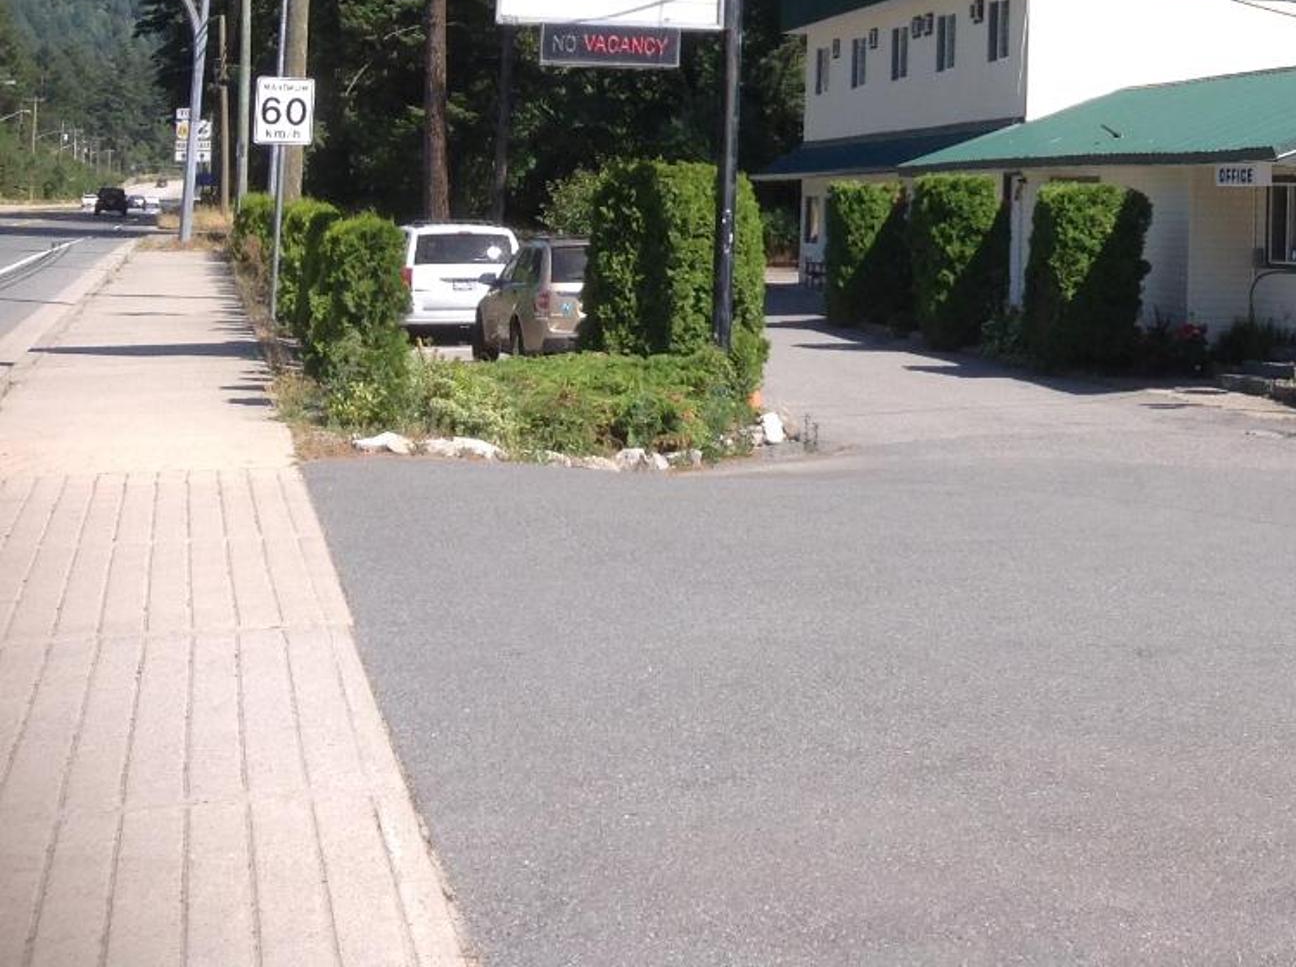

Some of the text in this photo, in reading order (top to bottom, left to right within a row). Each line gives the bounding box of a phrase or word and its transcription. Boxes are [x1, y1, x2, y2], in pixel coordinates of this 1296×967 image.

[552, 34, 669, 56] NO VACANCY
[261, 96, 307, 126] 60
[1218, 167, 1254, 184] OFFICE
